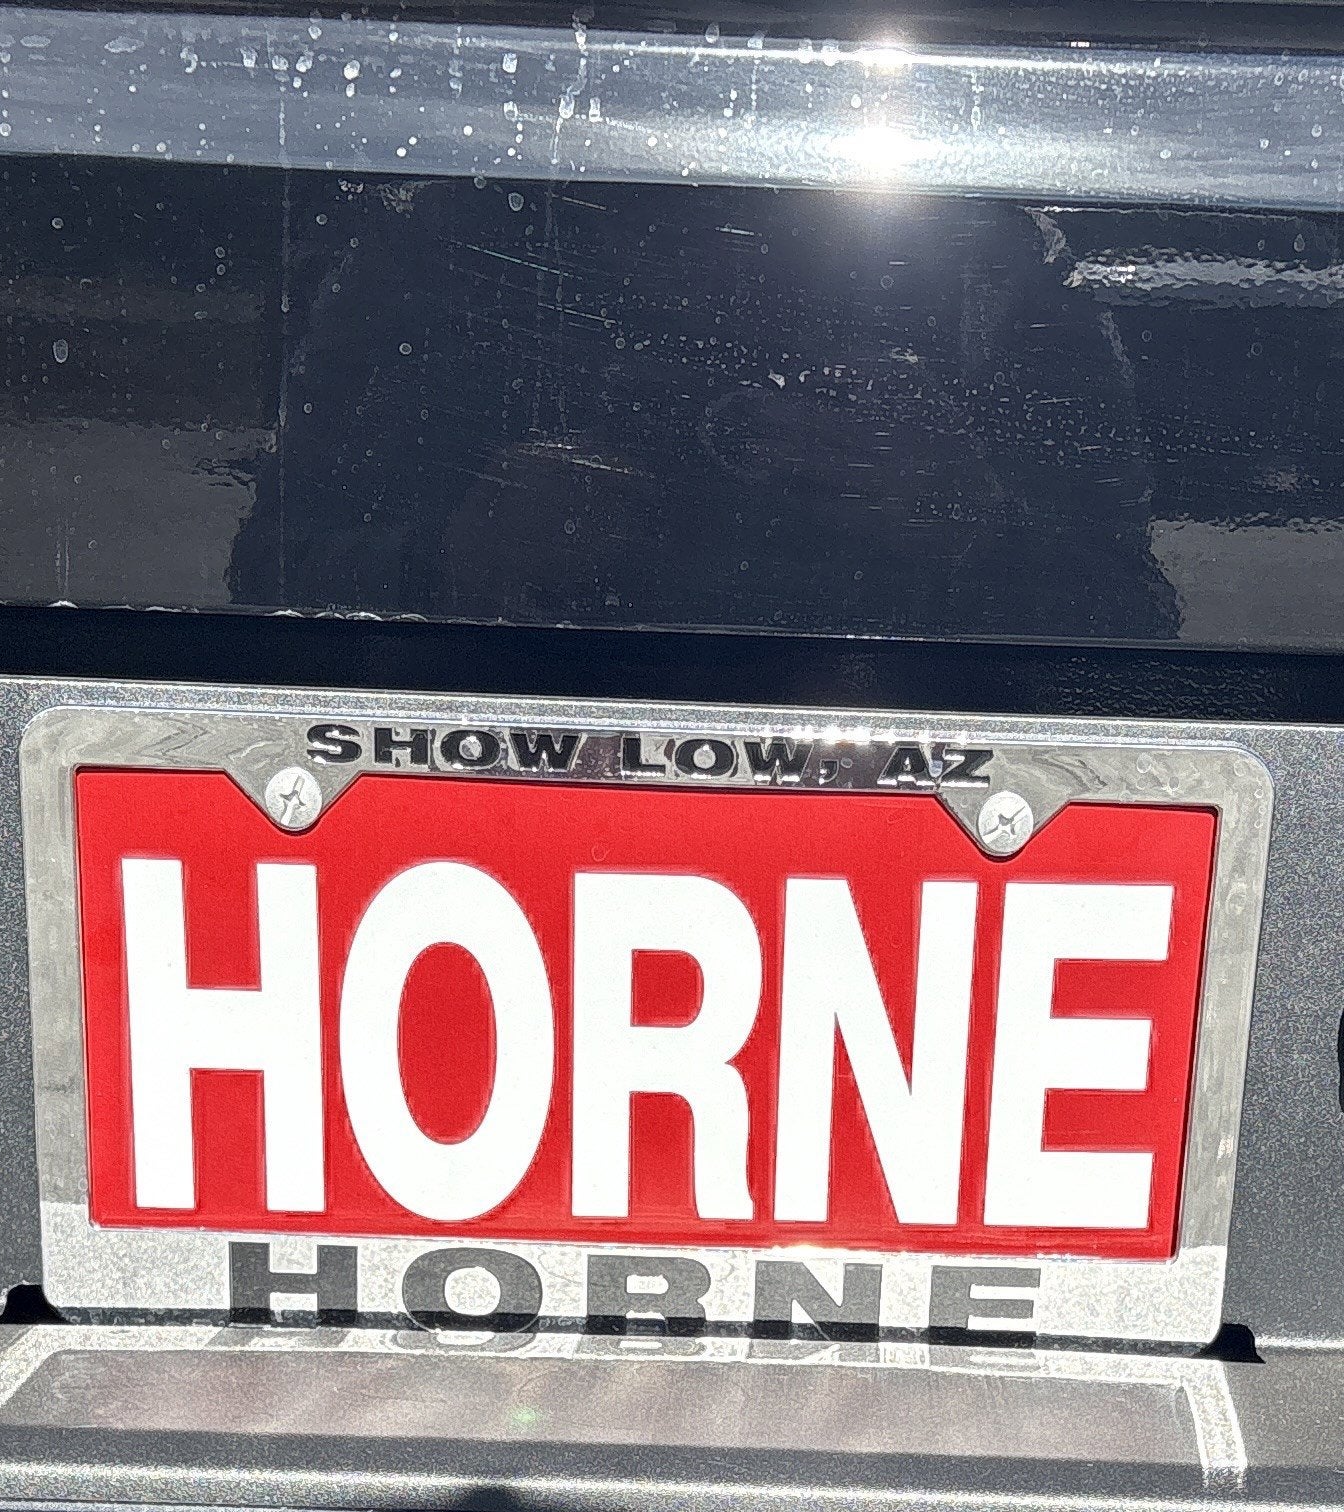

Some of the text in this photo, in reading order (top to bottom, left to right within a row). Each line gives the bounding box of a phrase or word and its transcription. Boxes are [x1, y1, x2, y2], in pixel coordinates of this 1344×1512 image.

[306, 723, 993, 788] SHOW LOW, AZ
[120, 857, 1175, 1230] HORNE
[227, 1240, 1042, 1345] HORNE
